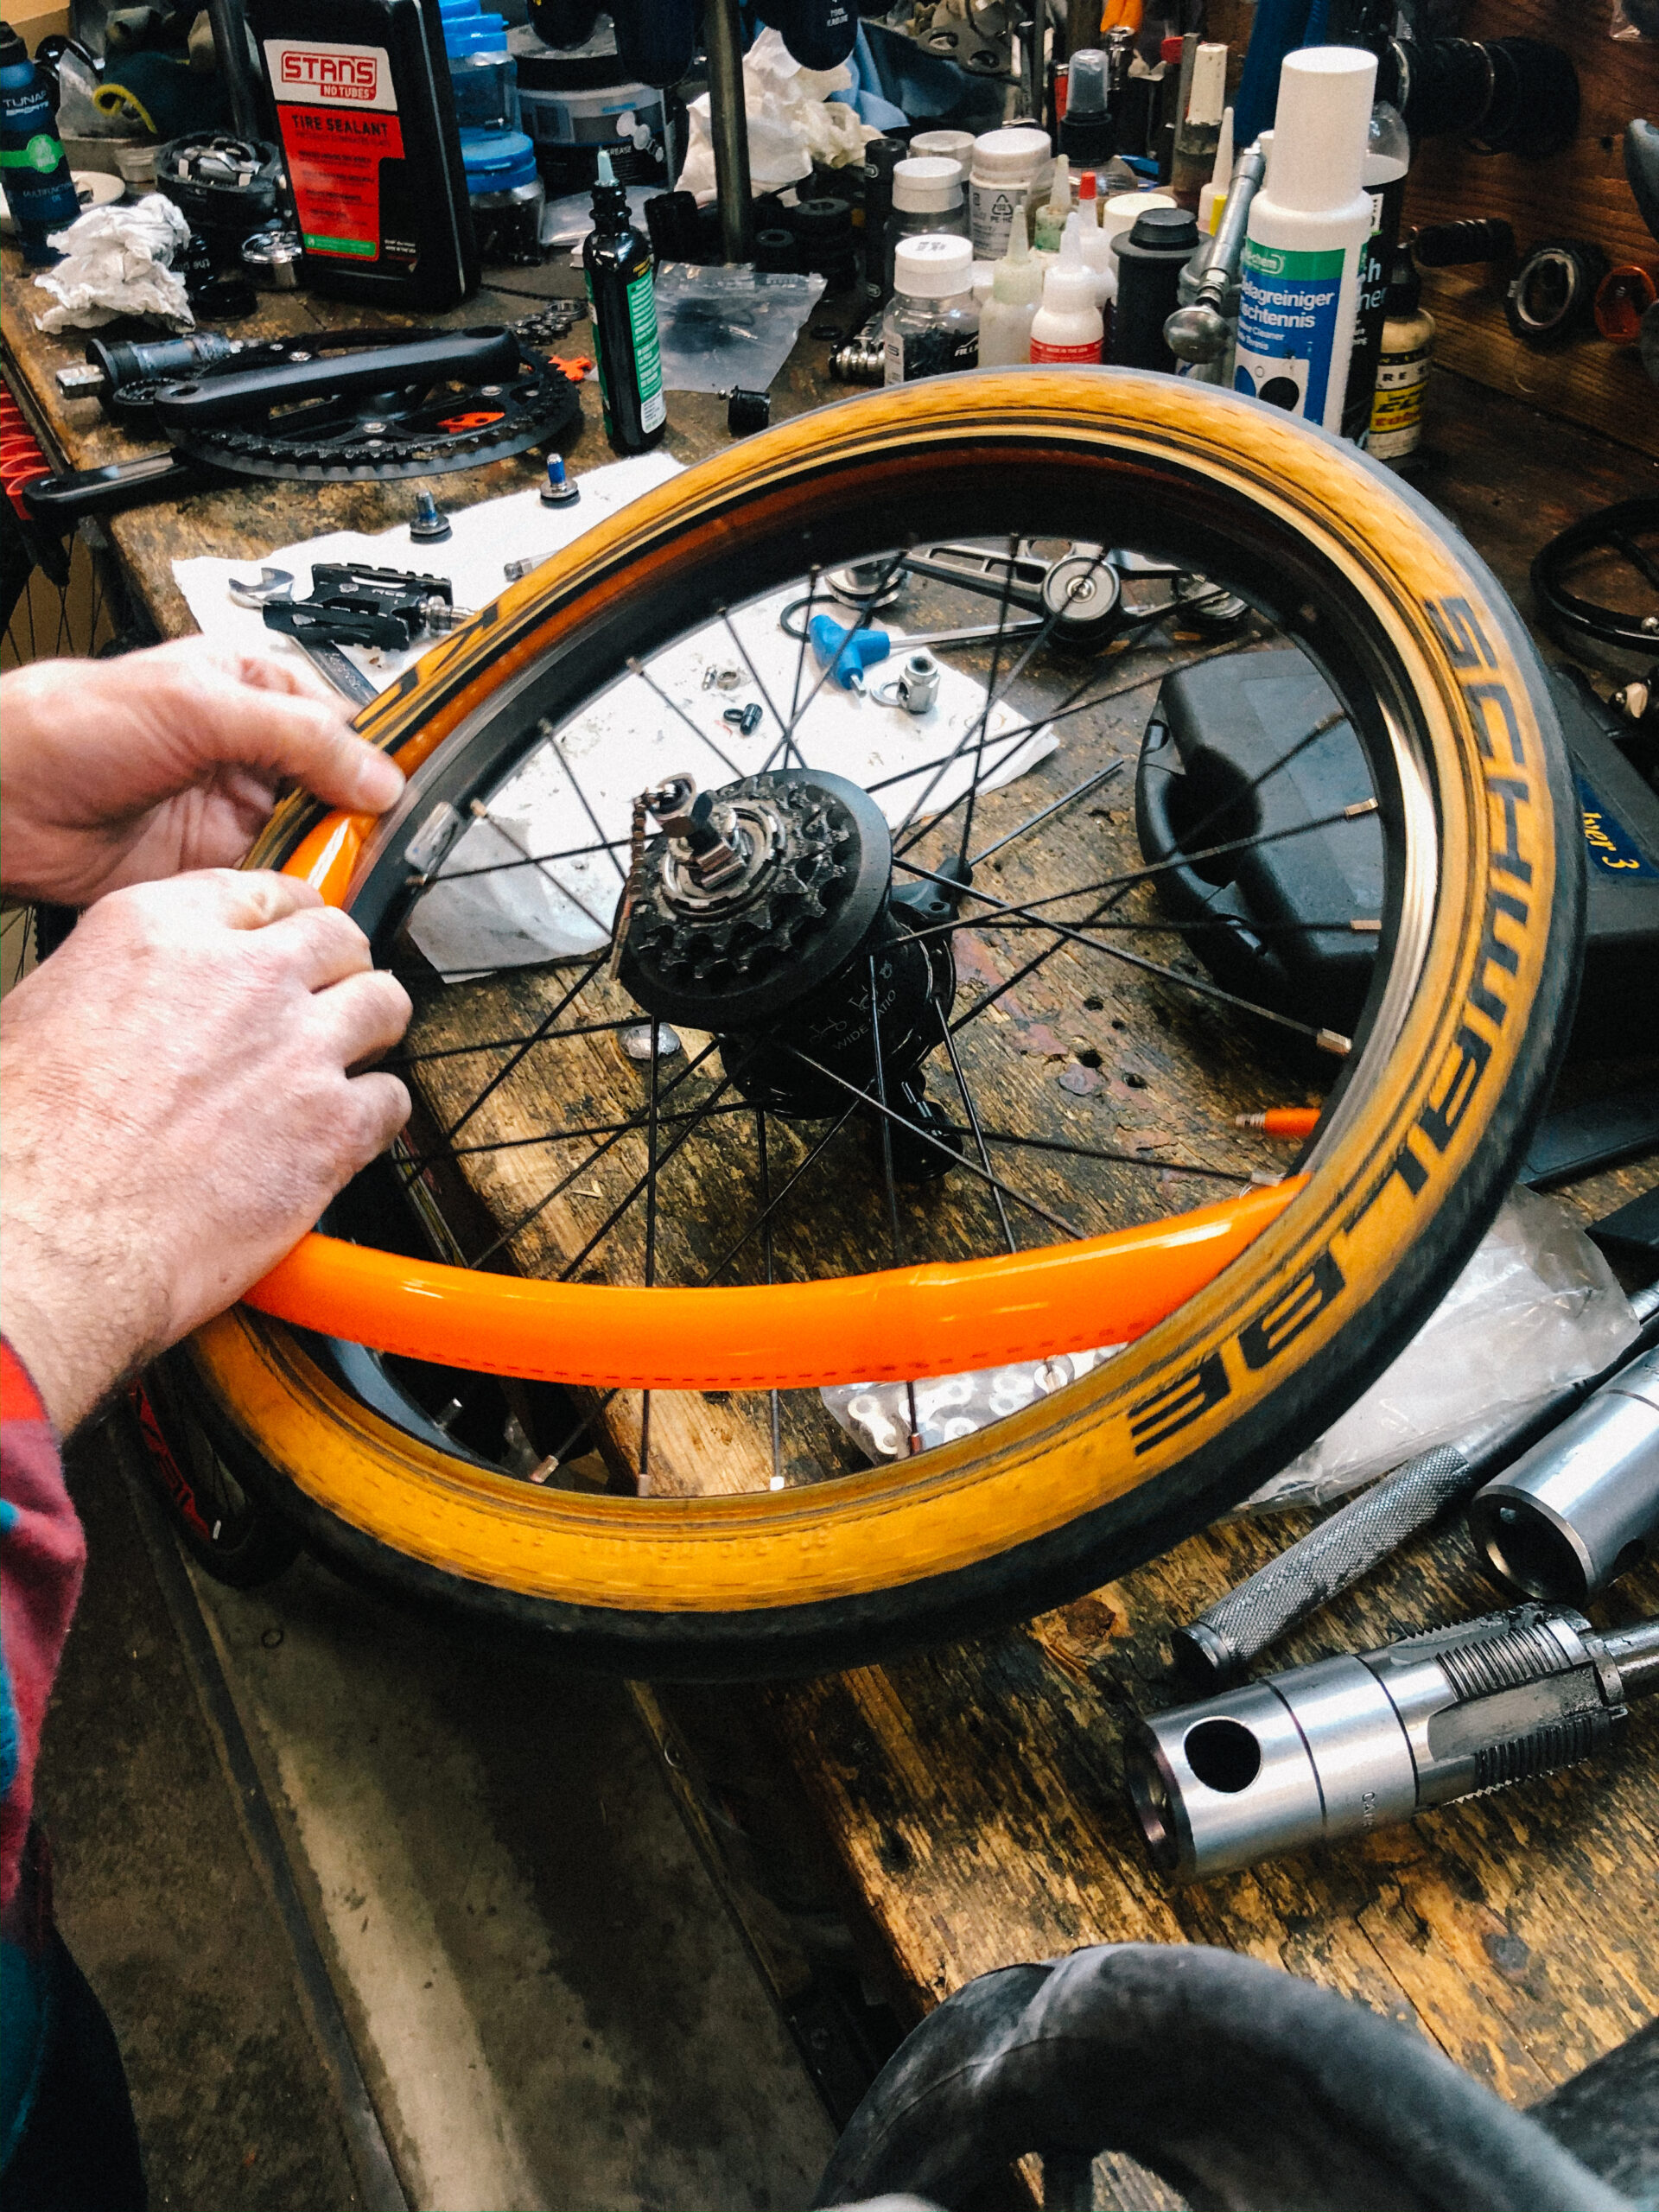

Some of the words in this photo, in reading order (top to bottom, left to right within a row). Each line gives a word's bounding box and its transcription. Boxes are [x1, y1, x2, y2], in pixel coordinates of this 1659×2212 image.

[323, 85, 337, 96] NO
[340, 87, 370, 99] TUBES
[291, 114, 323, 130] TIRE
[326, 117, 388, 137] SEALANT
[1601, 855, 1640, 869] 3
[832, 1024, 869, 1051] WIDE
[868, 989, 896, 1022] ATIO
[1127, 595, 1533, 1457] SCHWALBE
